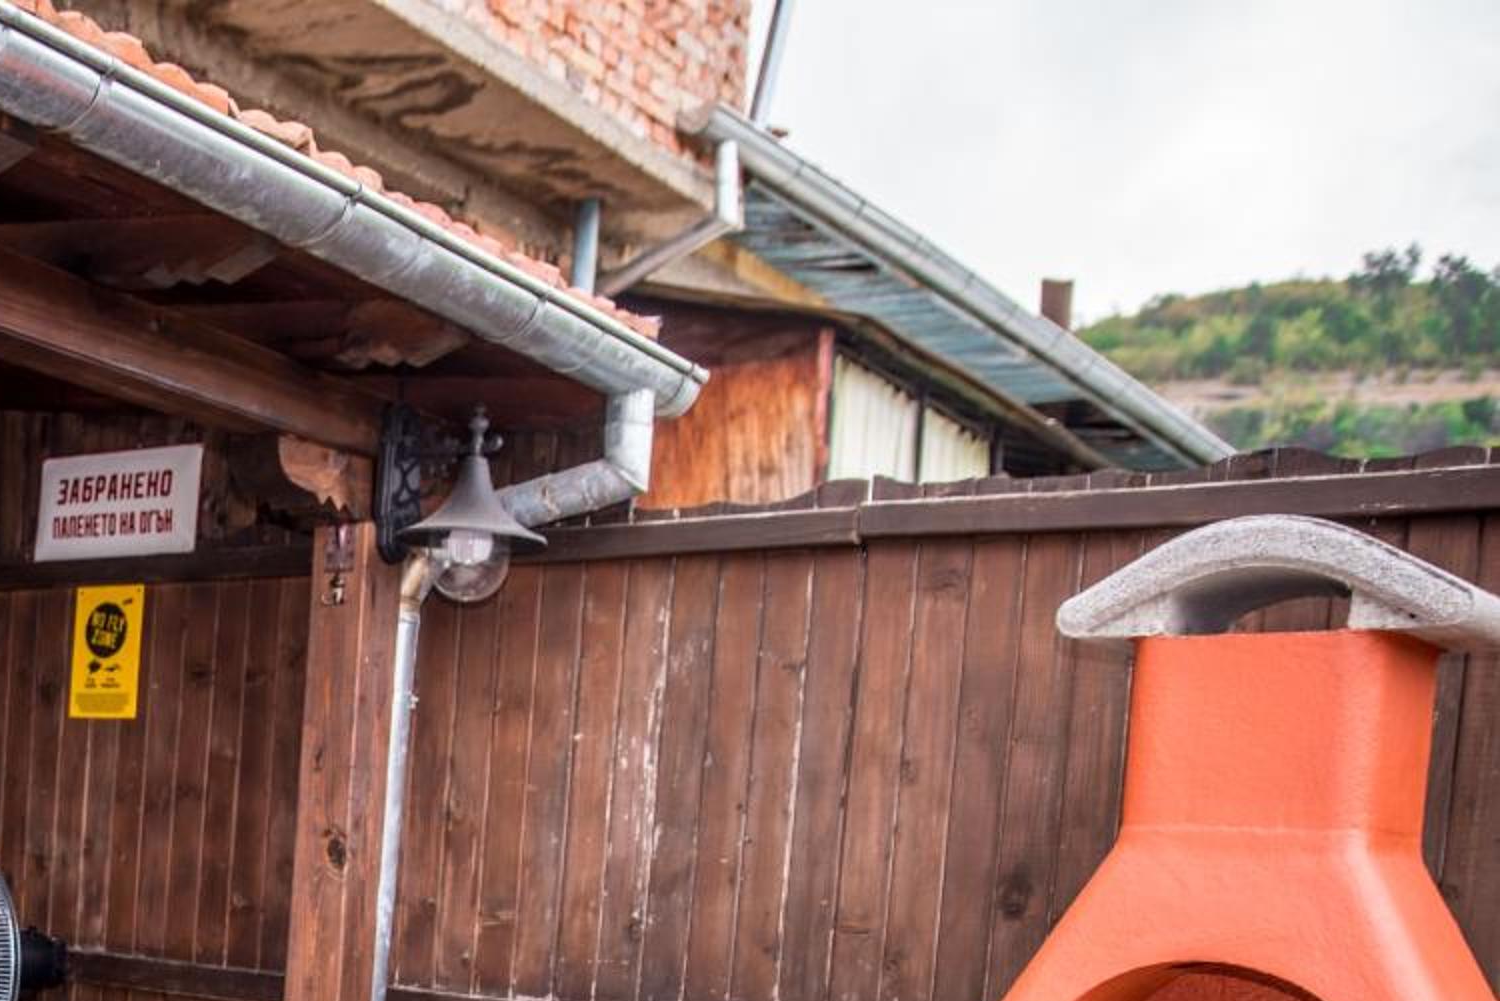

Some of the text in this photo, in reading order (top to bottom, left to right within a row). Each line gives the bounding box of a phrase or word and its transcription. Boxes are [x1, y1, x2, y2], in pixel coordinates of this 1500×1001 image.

[57, 469, 173, 505] ЗАБРАНЕНО
[119, 510, 136, 535] НА
[139, 508, 173, 534] ОГЪН
